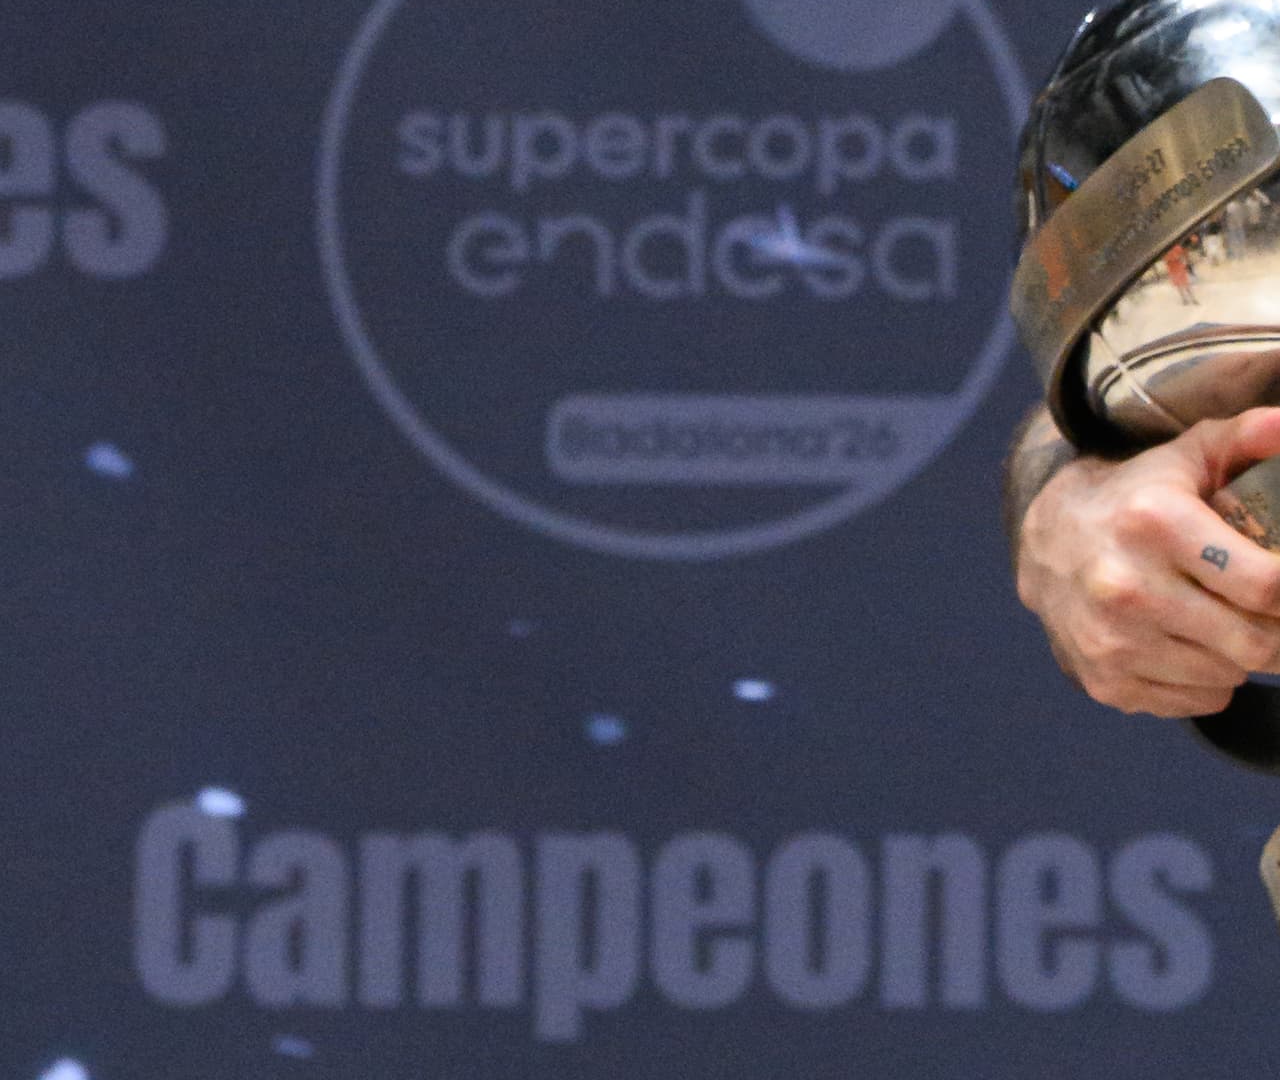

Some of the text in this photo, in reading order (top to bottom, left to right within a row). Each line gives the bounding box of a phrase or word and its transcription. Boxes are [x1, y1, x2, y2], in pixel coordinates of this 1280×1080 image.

[399, 110, 959, 195] supercopa
[447, 192, 958, 302] endesa
[1201, 545, 1229, 572] B
[134, 792, 1214, 1040] Campeones
